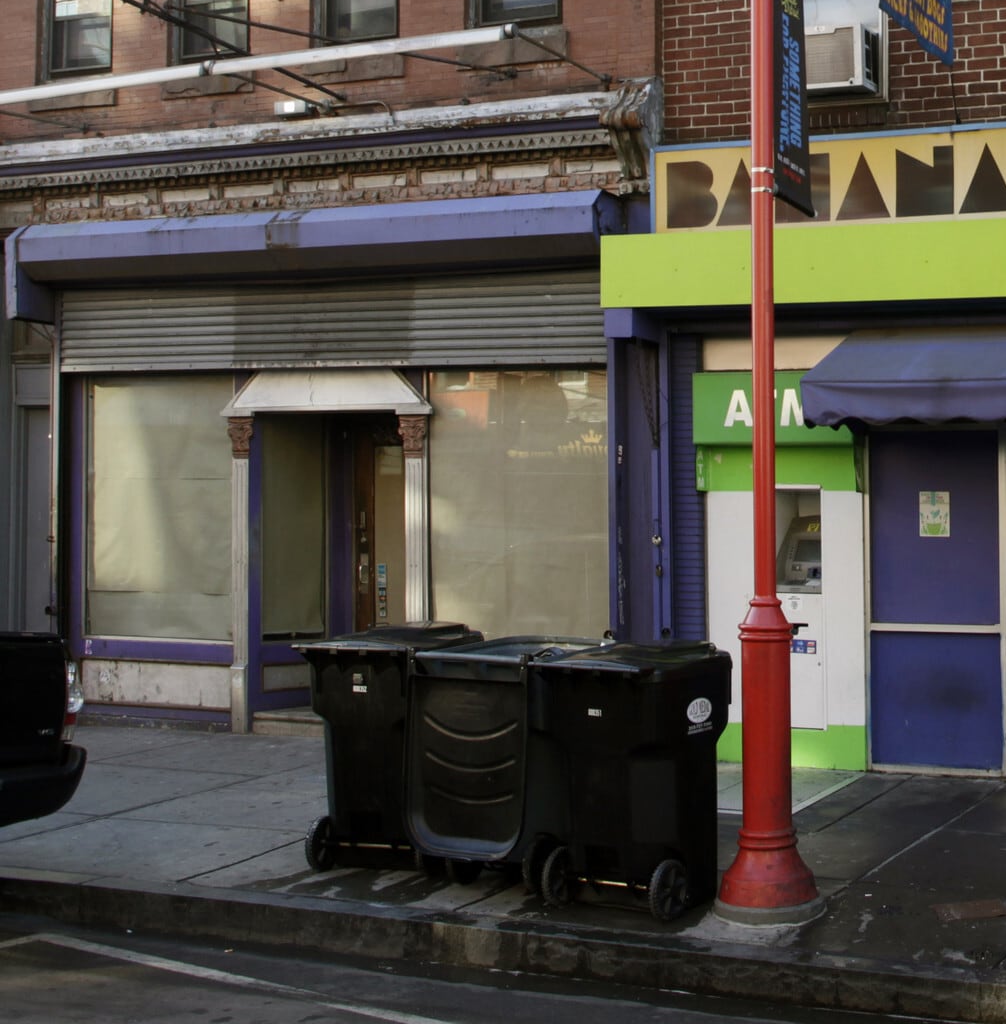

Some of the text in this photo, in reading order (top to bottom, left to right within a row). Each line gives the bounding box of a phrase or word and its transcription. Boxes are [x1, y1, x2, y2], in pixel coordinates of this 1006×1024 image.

[788, 36, 803, 149] SOMETHING
[723, 388, 805, 428] AM
[696, 450, 705, 489] ATM
